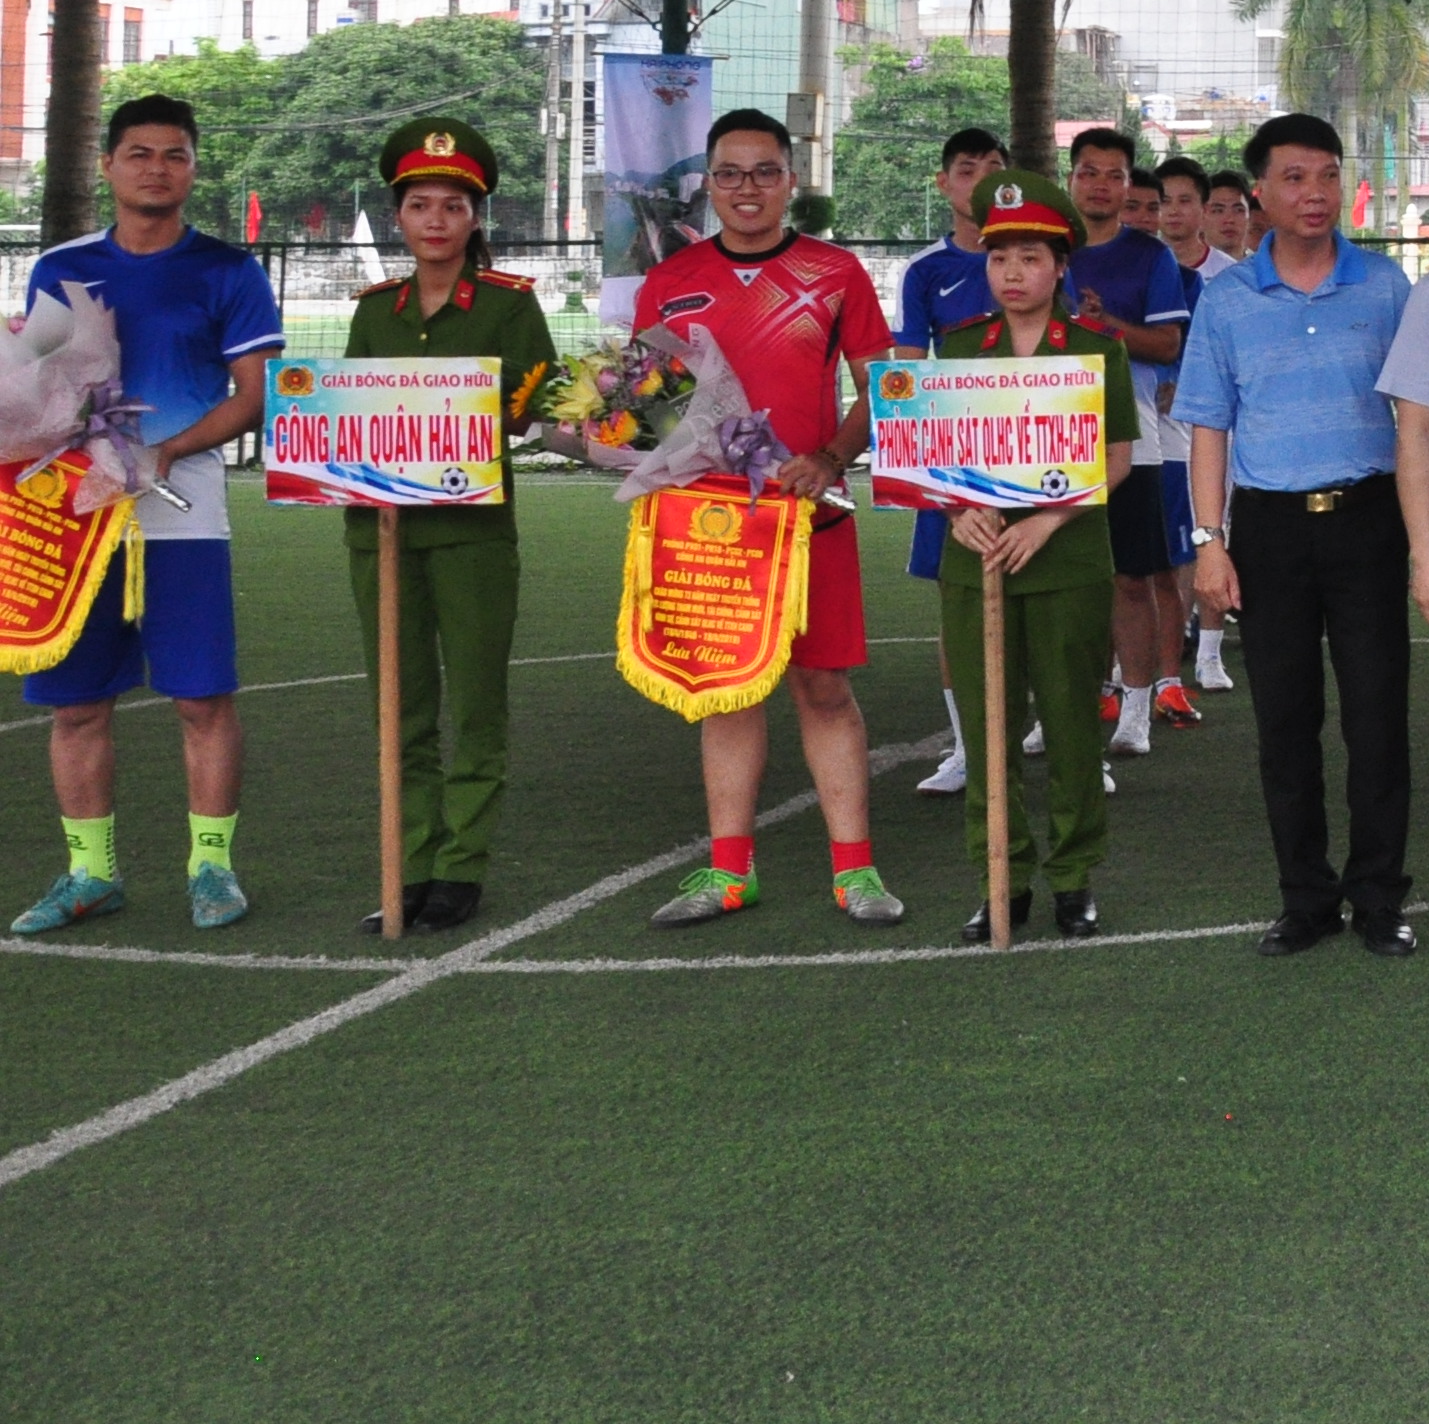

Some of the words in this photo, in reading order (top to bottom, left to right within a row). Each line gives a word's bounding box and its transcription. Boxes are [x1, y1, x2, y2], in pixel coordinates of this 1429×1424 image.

[321, 371, 352, 388] GIẢI
[355, 371, 396, 388] BÓNG
[400, 371, 419, 387] ĐÁ
[423, 373, 461, 388] GIAO
[464, 371, 493, 387] HỮU
[921, 374, 951, 391] GIẢI
[955, 372, 996, 389] BÓNG
[999, 371, 1019, 388] ĐÁ
[1022, 373, 1061, 388] GIAO
[1064, 369, 1095, 386] HỮU
[275, 404, 329, 464] CÔNG
[336, 414, 363, 463] AN
[369, 404, 422, 474] QUẬN
[429, 397, 461, 463] HẢI
[467, 414, 493, 463] AN
[877, 406, 919, 469] PHÒNG
[922, 400, 954, 468] CẢNH
[957, 406, 979, 466] SÁT
[982, 414, 1014, 472] QLHC
[1015, 398, 1032, 465] VỀ
[1034, 413, 1098, 465] TTXH-CATP
[664, 567, 692, 585] GIẢI
[694, 571, 731, 588] BÓNG
